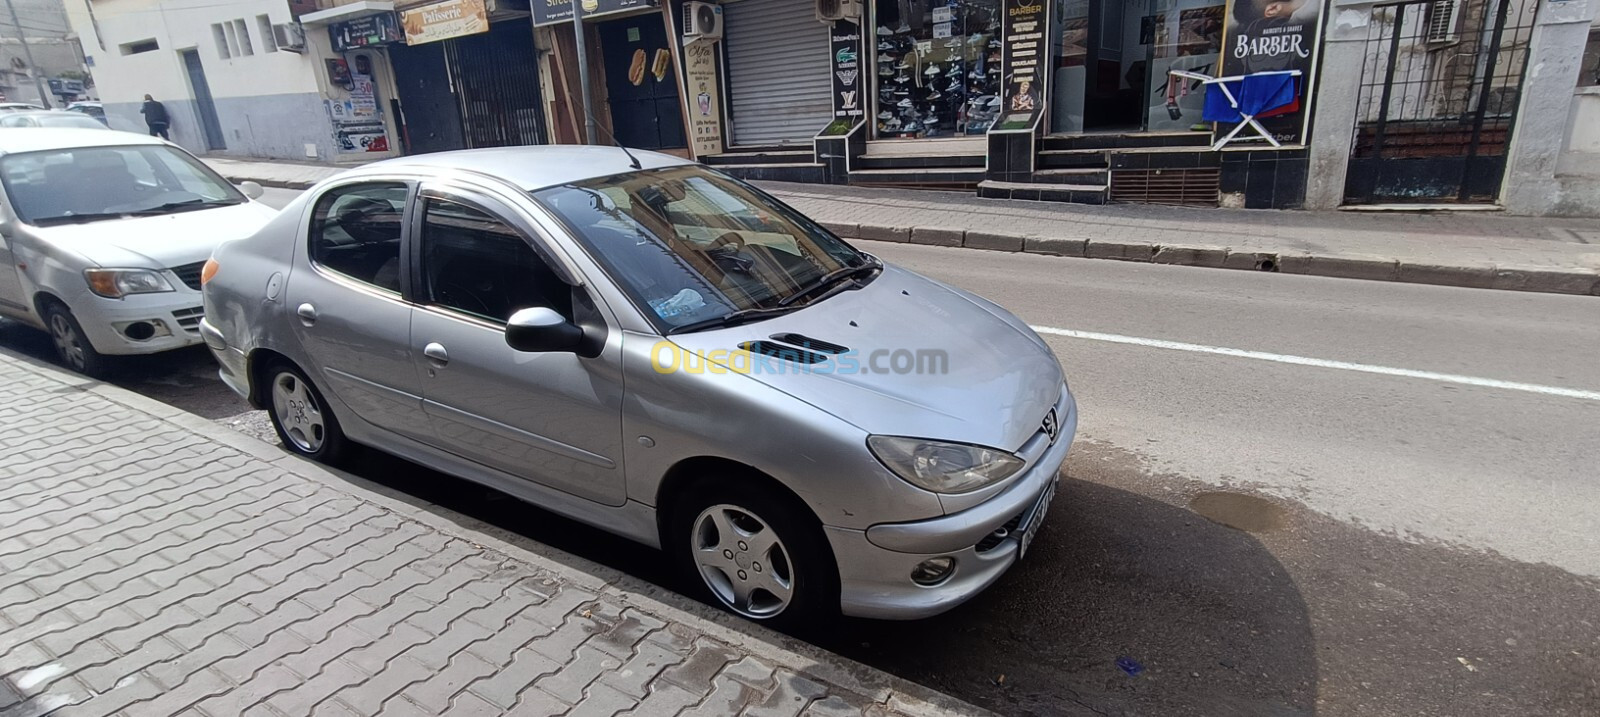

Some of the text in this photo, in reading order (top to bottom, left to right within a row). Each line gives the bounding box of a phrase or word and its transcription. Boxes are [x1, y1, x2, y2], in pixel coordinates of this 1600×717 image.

[422, 5, 461, 24] Patisserie
[1009, 5, 1041, 16] BARBER
[1234, 33, 1310, 58] BARBER
[360, 82, 373, 94] 50
